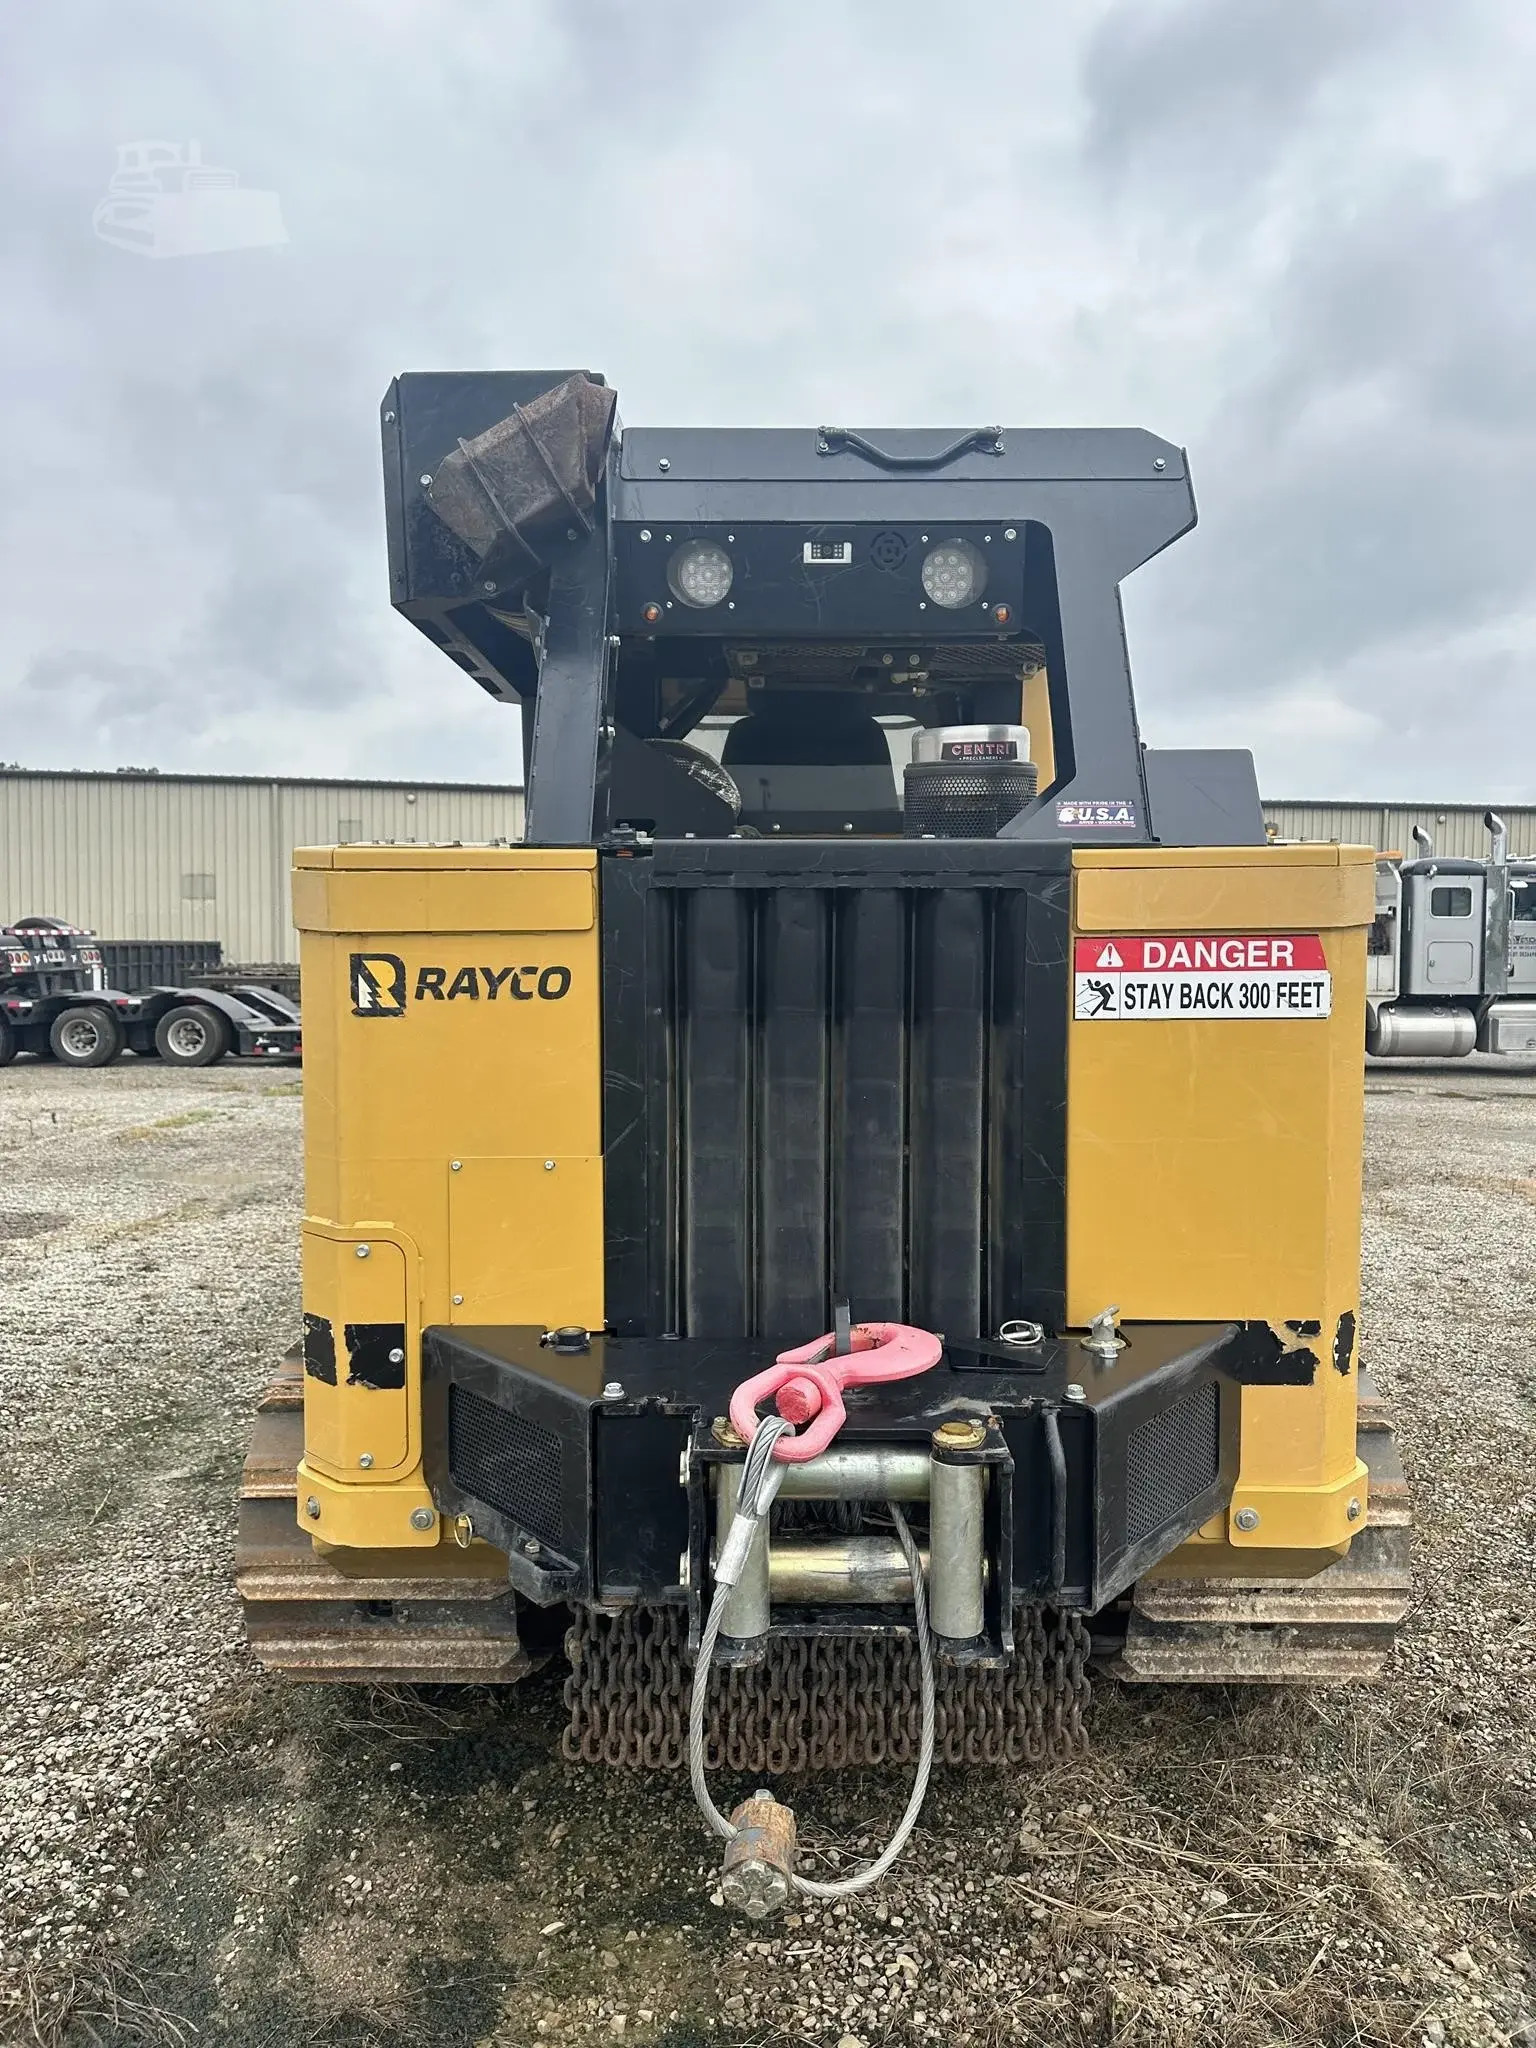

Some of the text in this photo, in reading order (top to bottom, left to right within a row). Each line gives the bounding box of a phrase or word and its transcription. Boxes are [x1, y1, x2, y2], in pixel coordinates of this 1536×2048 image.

[951, 744, 1009, 756] CENTRI
[1078, 807, 1135, 820] U.S.A.
[1142, 940, 1294, 969] DANGER
[414, 965, 572, 1001] RAYCO
[1124, 981, 1325, 1010] STAY BACK 300 FEET
